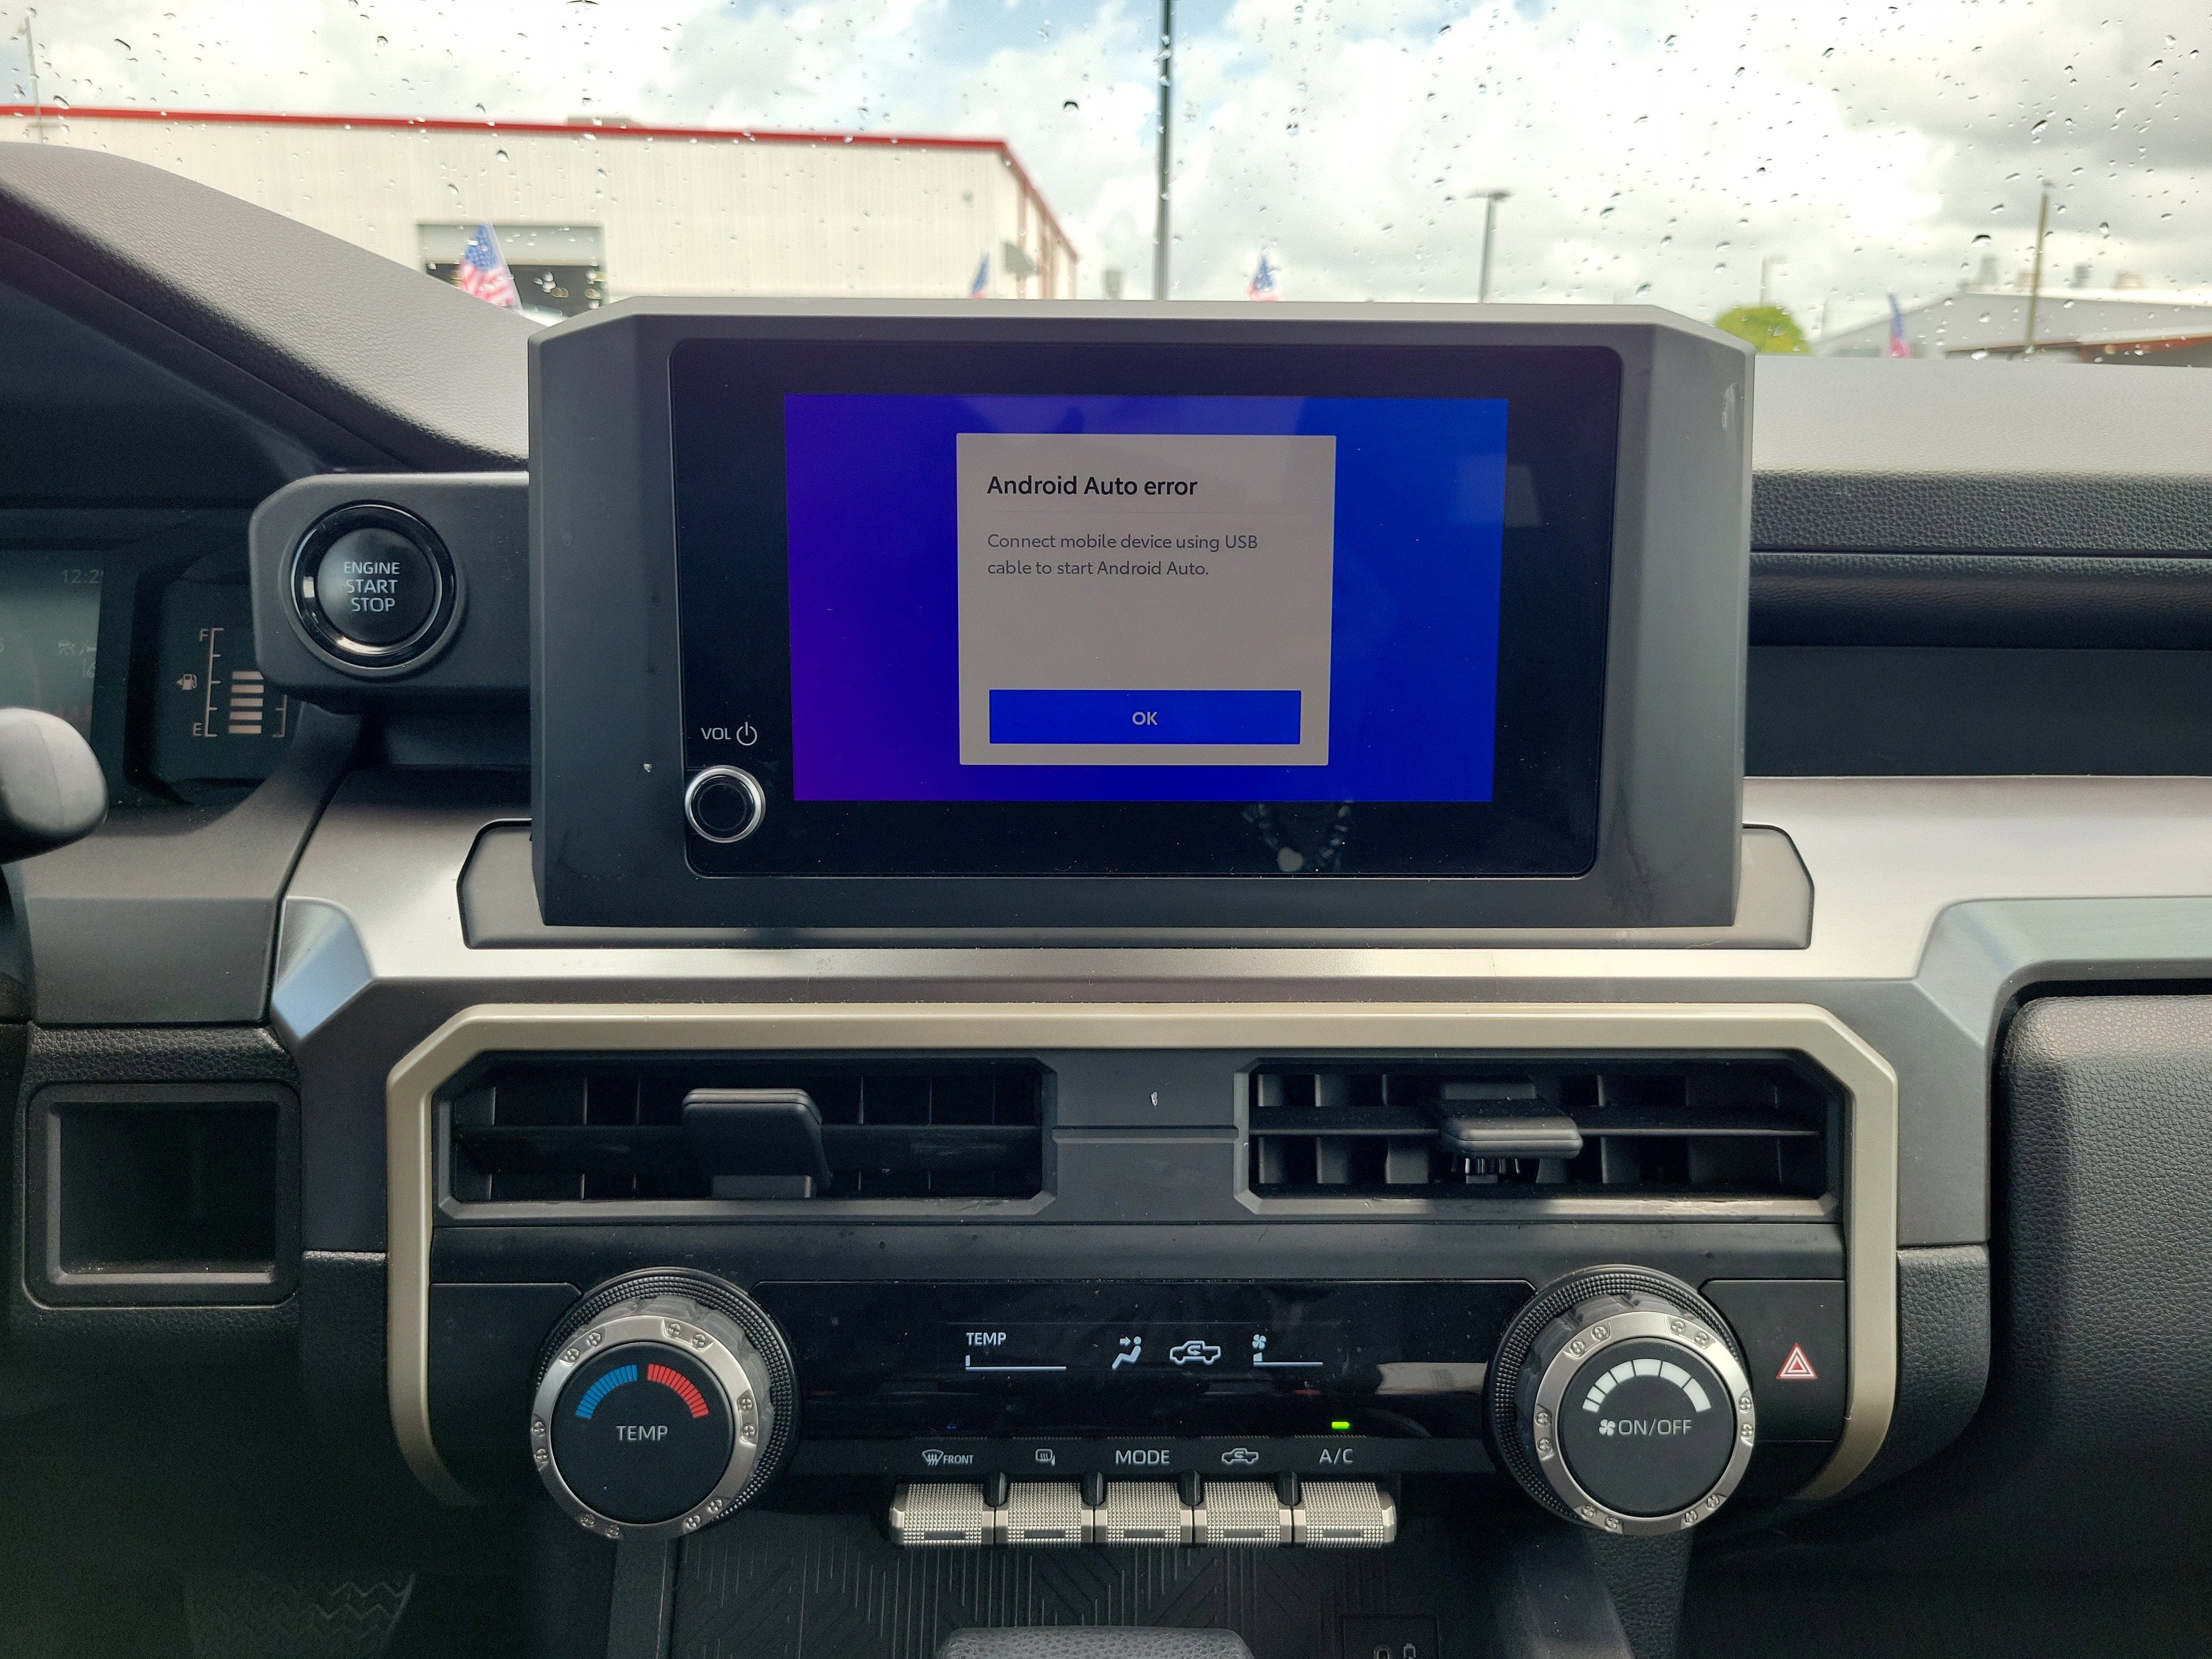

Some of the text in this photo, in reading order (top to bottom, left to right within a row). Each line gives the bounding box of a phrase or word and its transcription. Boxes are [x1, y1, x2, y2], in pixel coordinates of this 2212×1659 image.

[987, 476, 1198, 495] Android Auto error
[988, 534, 1257, 552] Connect mobile device using USB
[344, 562, 400, 574] ENGINE
[988, 560, 1209, 575] cable to start Android Auto.
[346, 579, 399, 594] START
[352, 597, 395, 612] STOP
[199, 629, 208, 641] F
[1132, 712, 1158, 725] OK
[193, 723, 202, 736] E
[701, 728, 731, 740] VOL
[966, 1333, 1006, 1345] TEMP
[617, 1426, 668, 1441] TEMP
[1618, 1419, 1692, 1436] ON/OFF
[943, 1454, 974, 1464] FRONT
[1116, 1450, 1169, 1464] MODE
[1319, 1448, 1352, 1464] A/C
